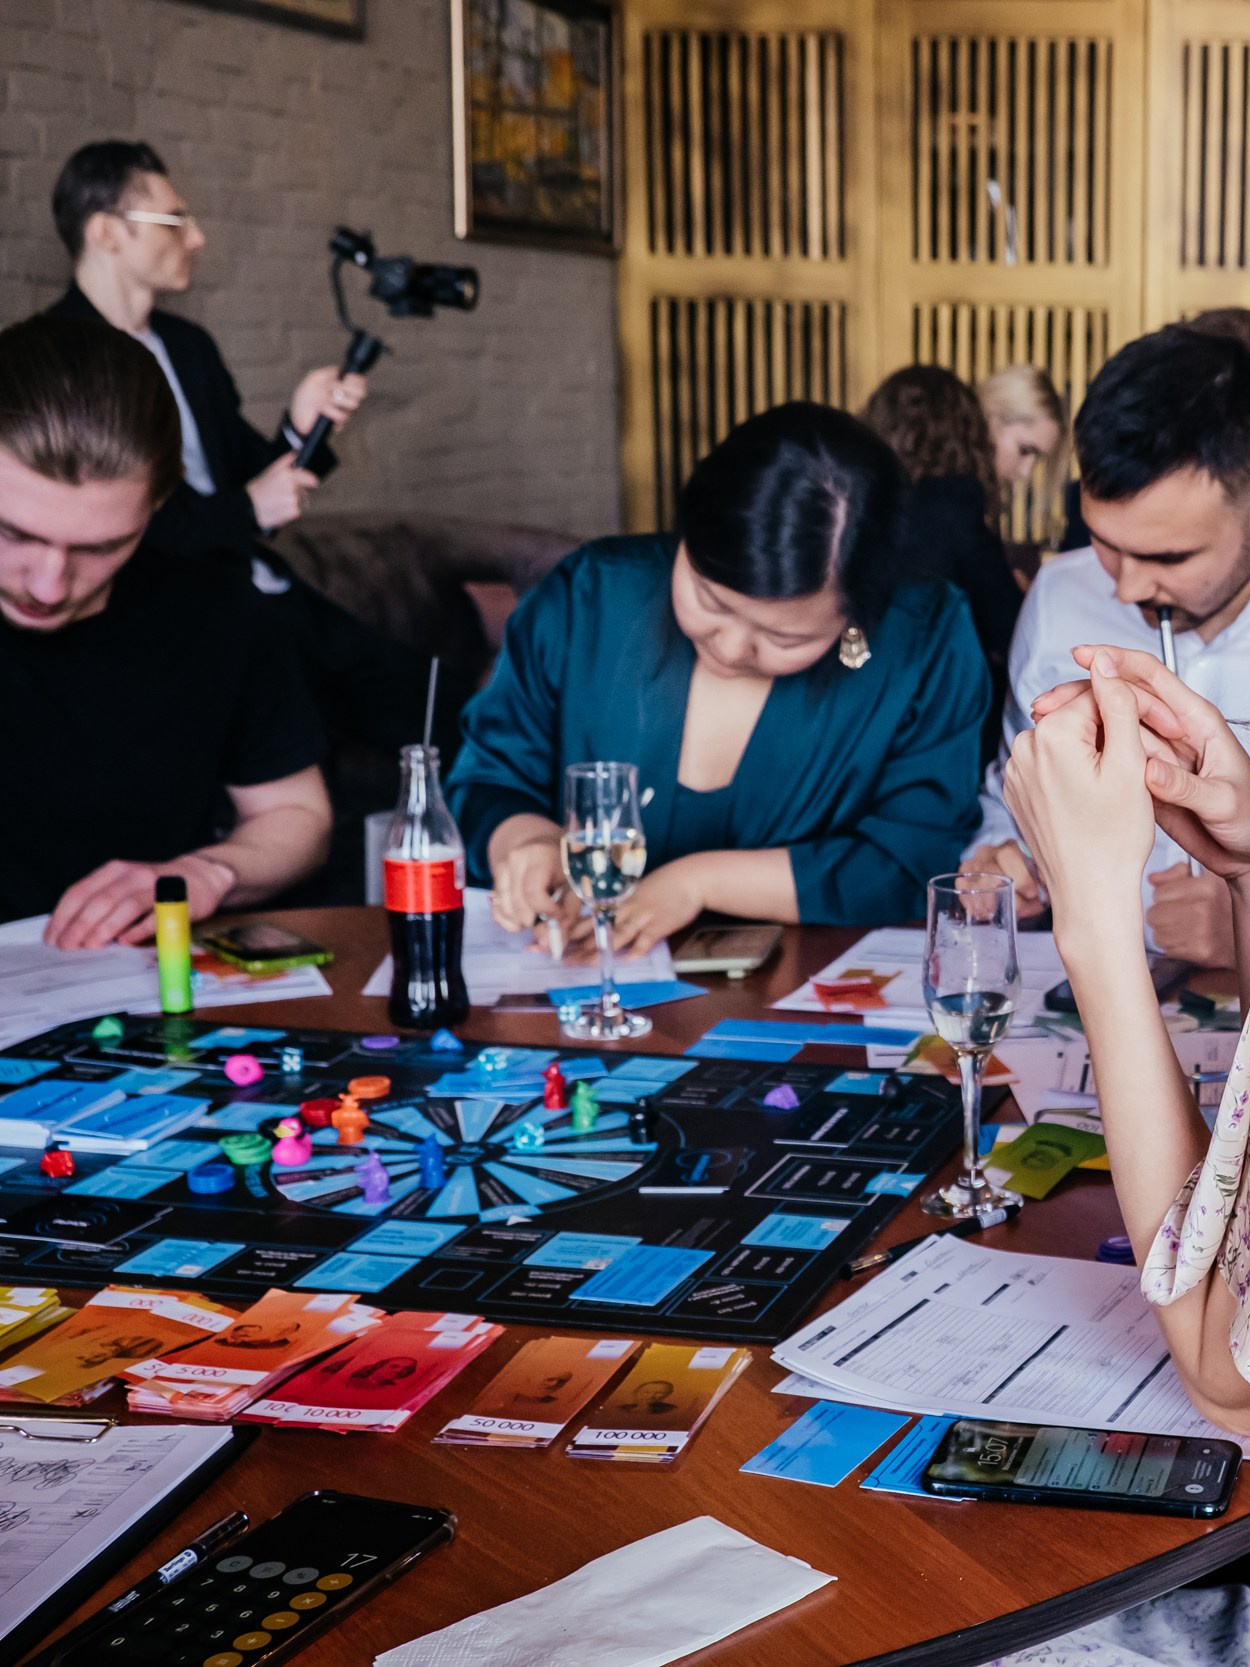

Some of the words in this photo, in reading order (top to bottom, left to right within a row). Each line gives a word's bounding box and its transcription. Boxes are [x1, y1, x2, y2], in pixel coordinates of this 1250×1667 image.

[303, 1407, 325, 1417] 10
[326, 1409, 362, 1419] 000
[469, 1418, 495, 1428] 50
[497, 1421, 535, 1431] 000
[595, 1431, 628, 1440] 100
[631, 1431, 667, 1441] 000
[977, 1437, 1009, 1466] 15:07
[340, 1553, 378, 1568] 17
[200, 1578, 214, 1586] 7
[233, 1584, 247, 1593] 8
[267, 1590, 281, 1599] 9
[171, 1597, 185, 1606] 4
[205, 1603, 219, 1612] 5
[239, 1610, 253, 1619] 6
[175, 1623, 190, 1632] 2
[210, 1629, 225, 1638] 3
[110, 1637, 125, 1646] 0
